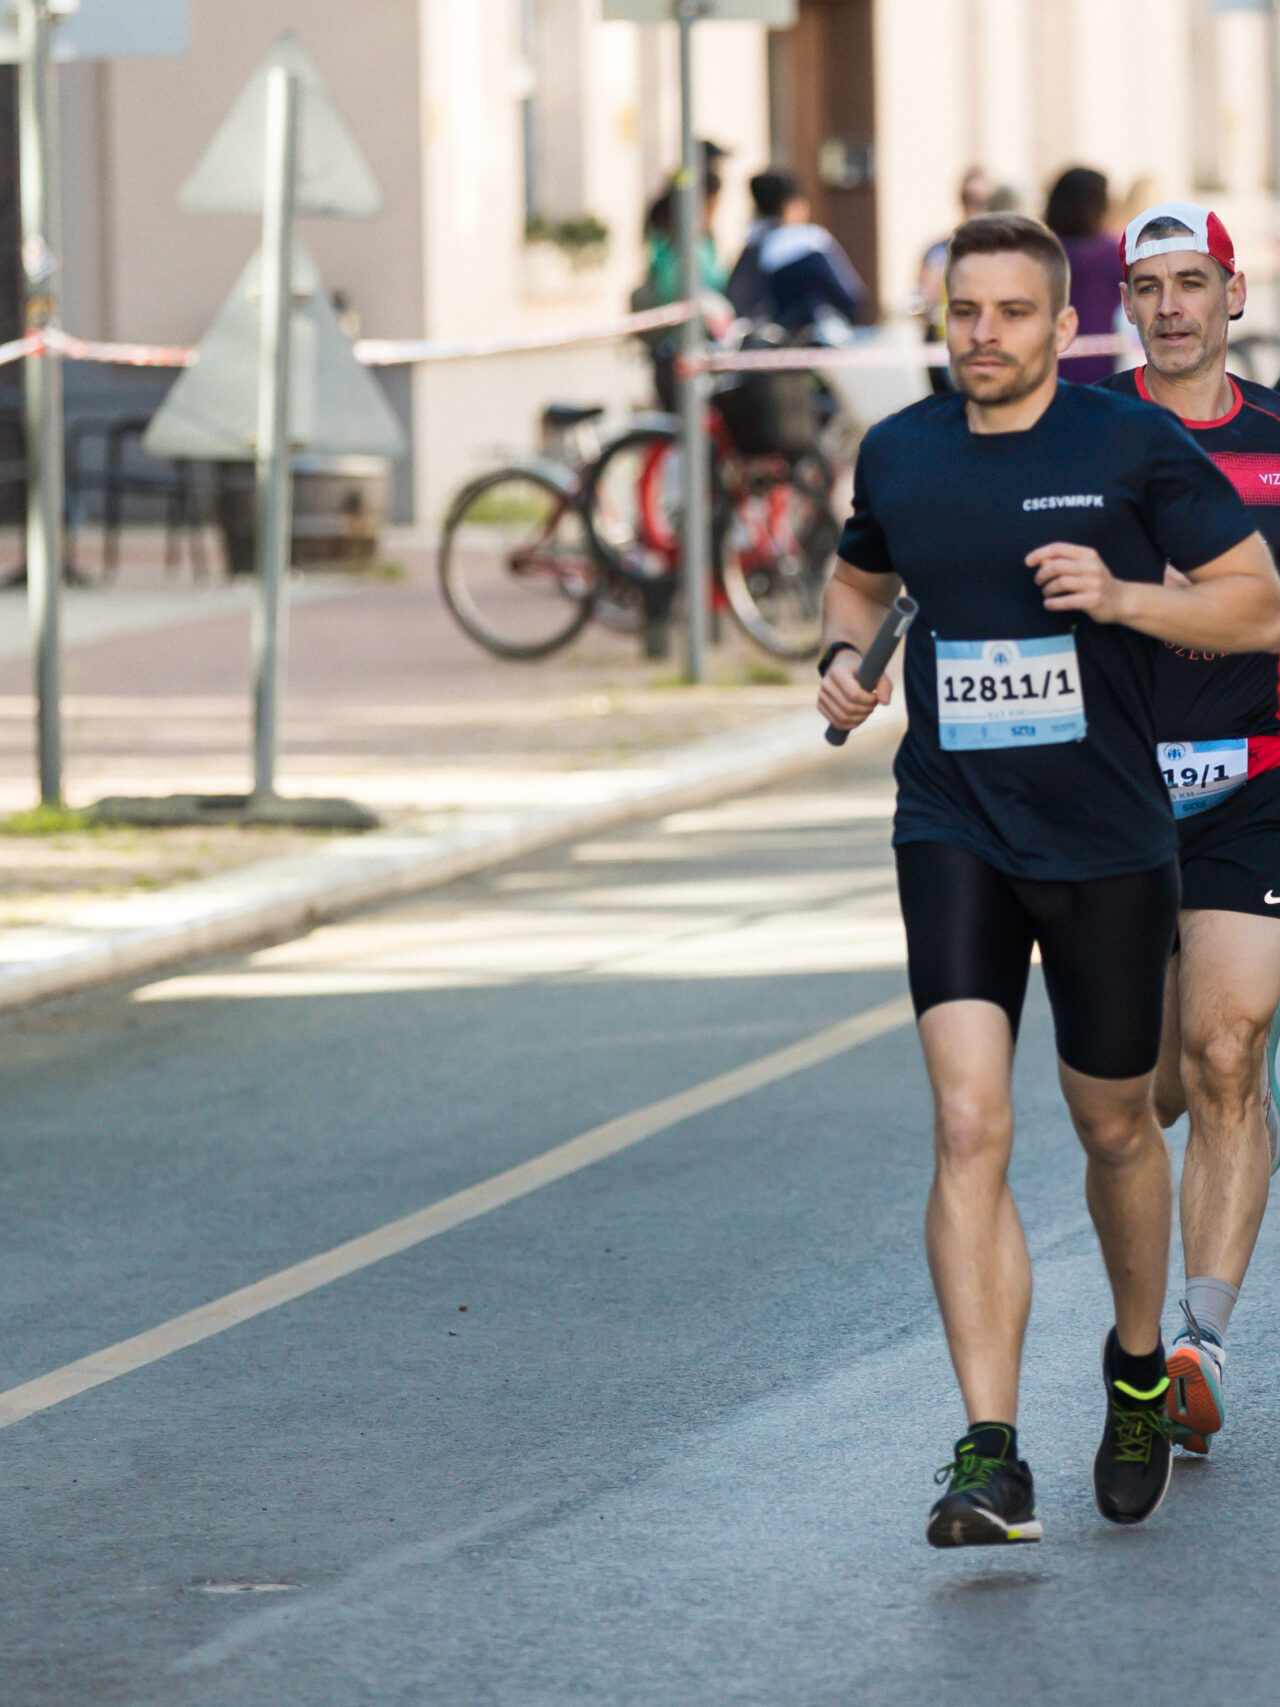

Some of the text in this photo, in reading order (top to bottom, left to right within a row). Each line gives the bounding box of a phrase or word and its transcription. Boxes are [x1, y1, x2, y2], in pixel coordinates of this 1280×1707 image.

[1022, 494, 1104, 512] CSCSVMRFK
[944, 669, 1075, 702] 12811/1
[1161, 764, 1229, 789] 19/1
